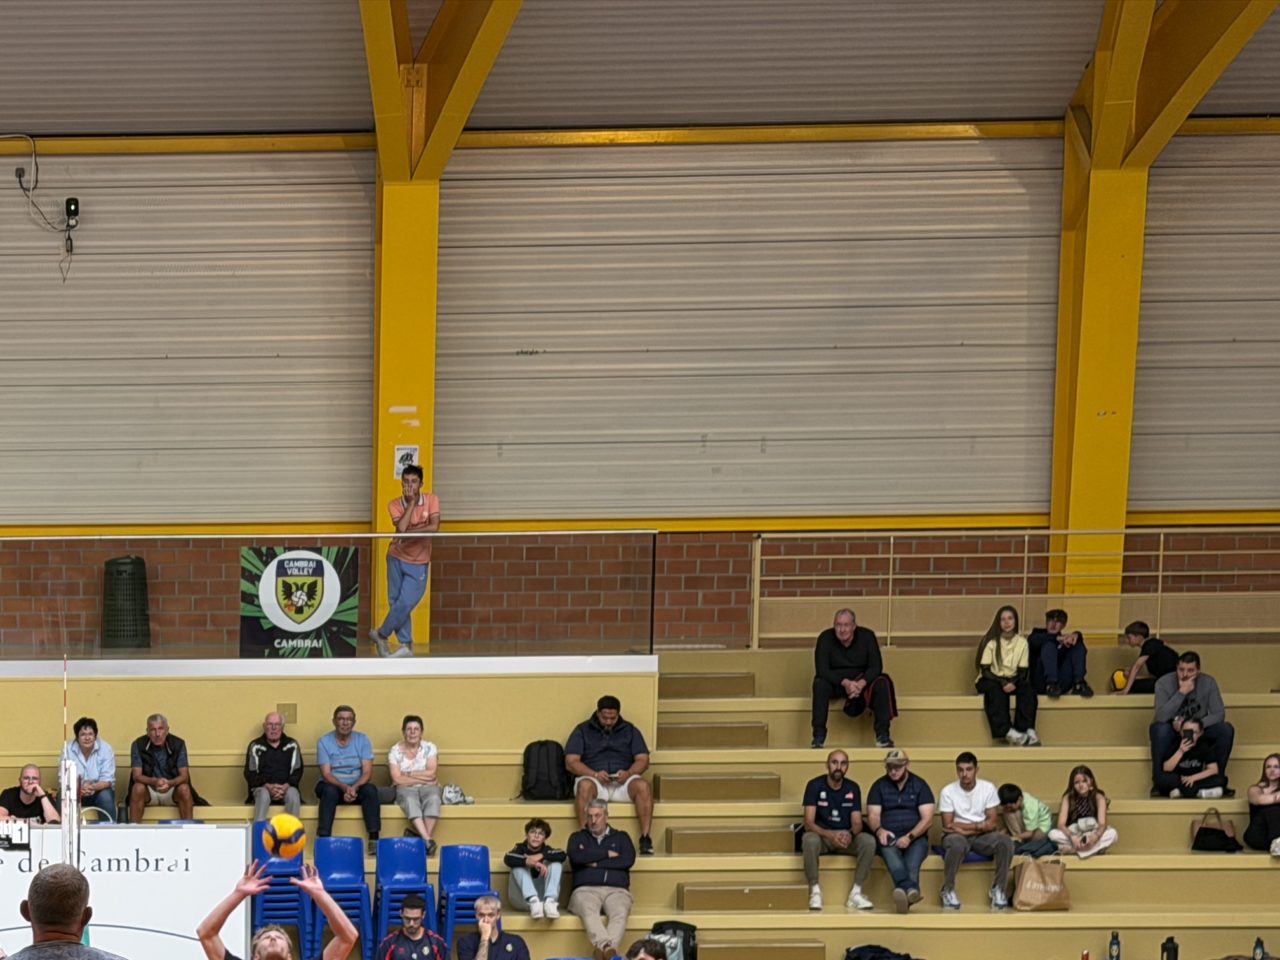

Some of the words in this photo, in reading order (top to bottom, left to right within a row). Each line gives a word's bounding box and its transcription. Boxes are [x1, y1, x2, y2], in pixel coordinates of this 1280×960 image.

[284, 560, 317, 568] CAMBRAI
[286, 567, 314, 575] VOLLEY
[273, 639, 322, 649] CAMBRAI
[17, 848, 51, 873] de
